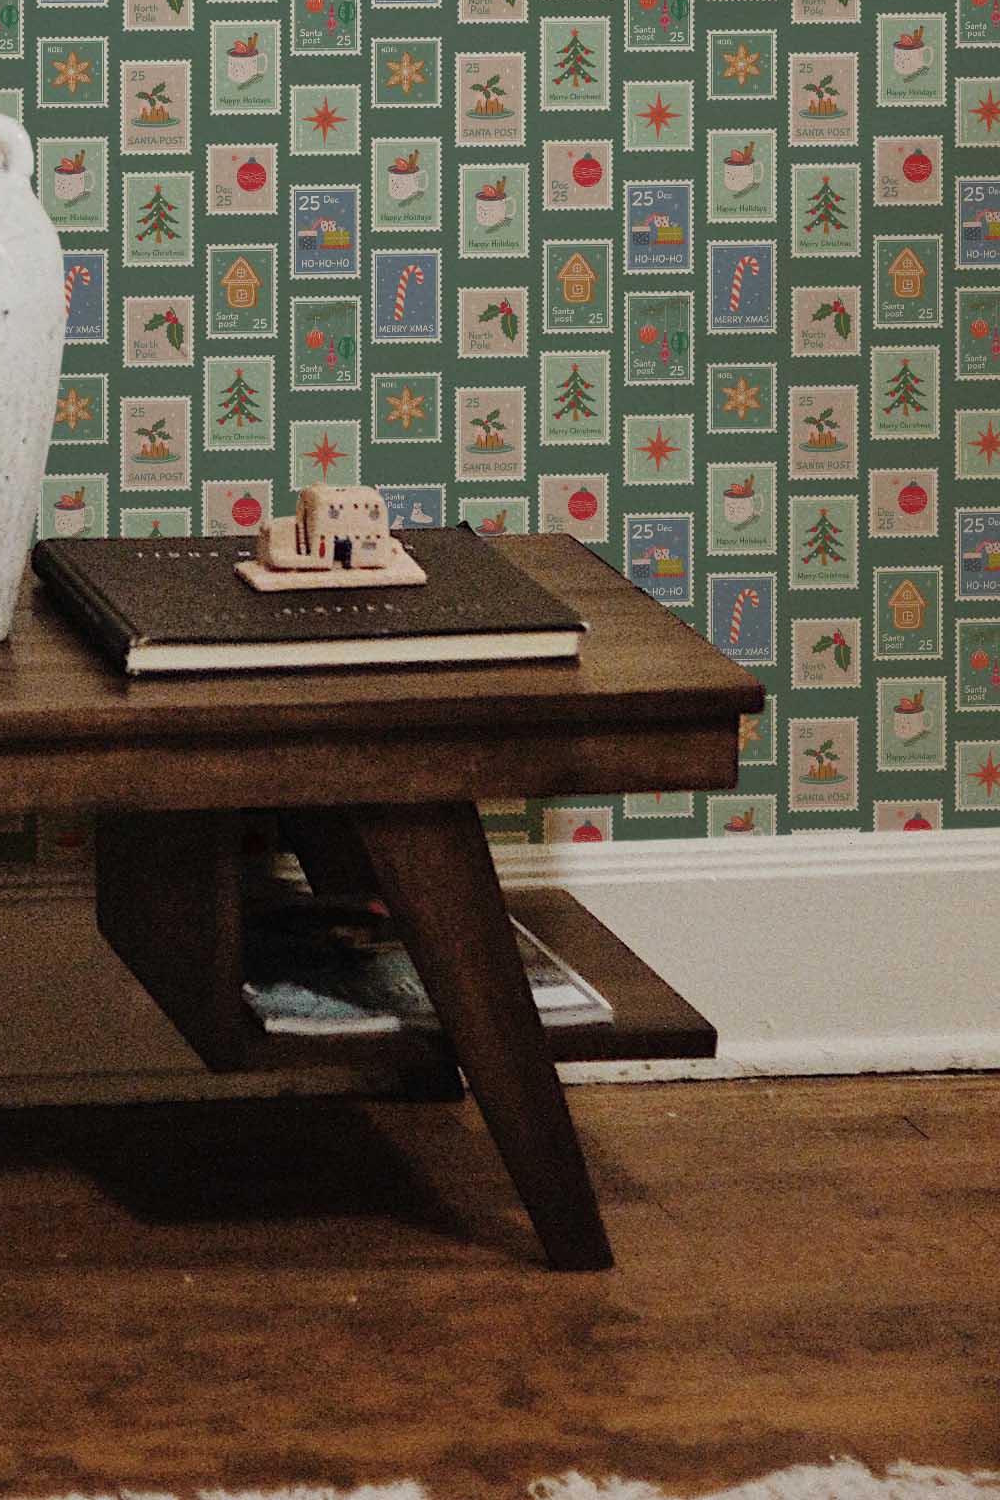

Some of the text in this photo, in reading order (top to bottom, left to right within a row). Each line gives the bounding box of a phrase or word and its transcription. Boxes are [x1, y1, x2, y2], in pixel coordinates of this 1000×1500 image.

[335, 35, 351, 46] 25
[130, 70, 146, 81] 25
[297, 194, 321, 211] 25
[631, 190, 655, 206] 25
[634, 253, 684, 263] HO-HO-HO
[300, 259, 351, 269] HO-HO-HO
[588, 313, 604, 324] 25
[918, 308, 934, 319] 25
[252, 318, 268, 329] 25
[714, 315, 771, 324] MERRY XMAS
[379, 324, 436, 333] MERRY XMAS
[668, 365, 684, 376] 25
